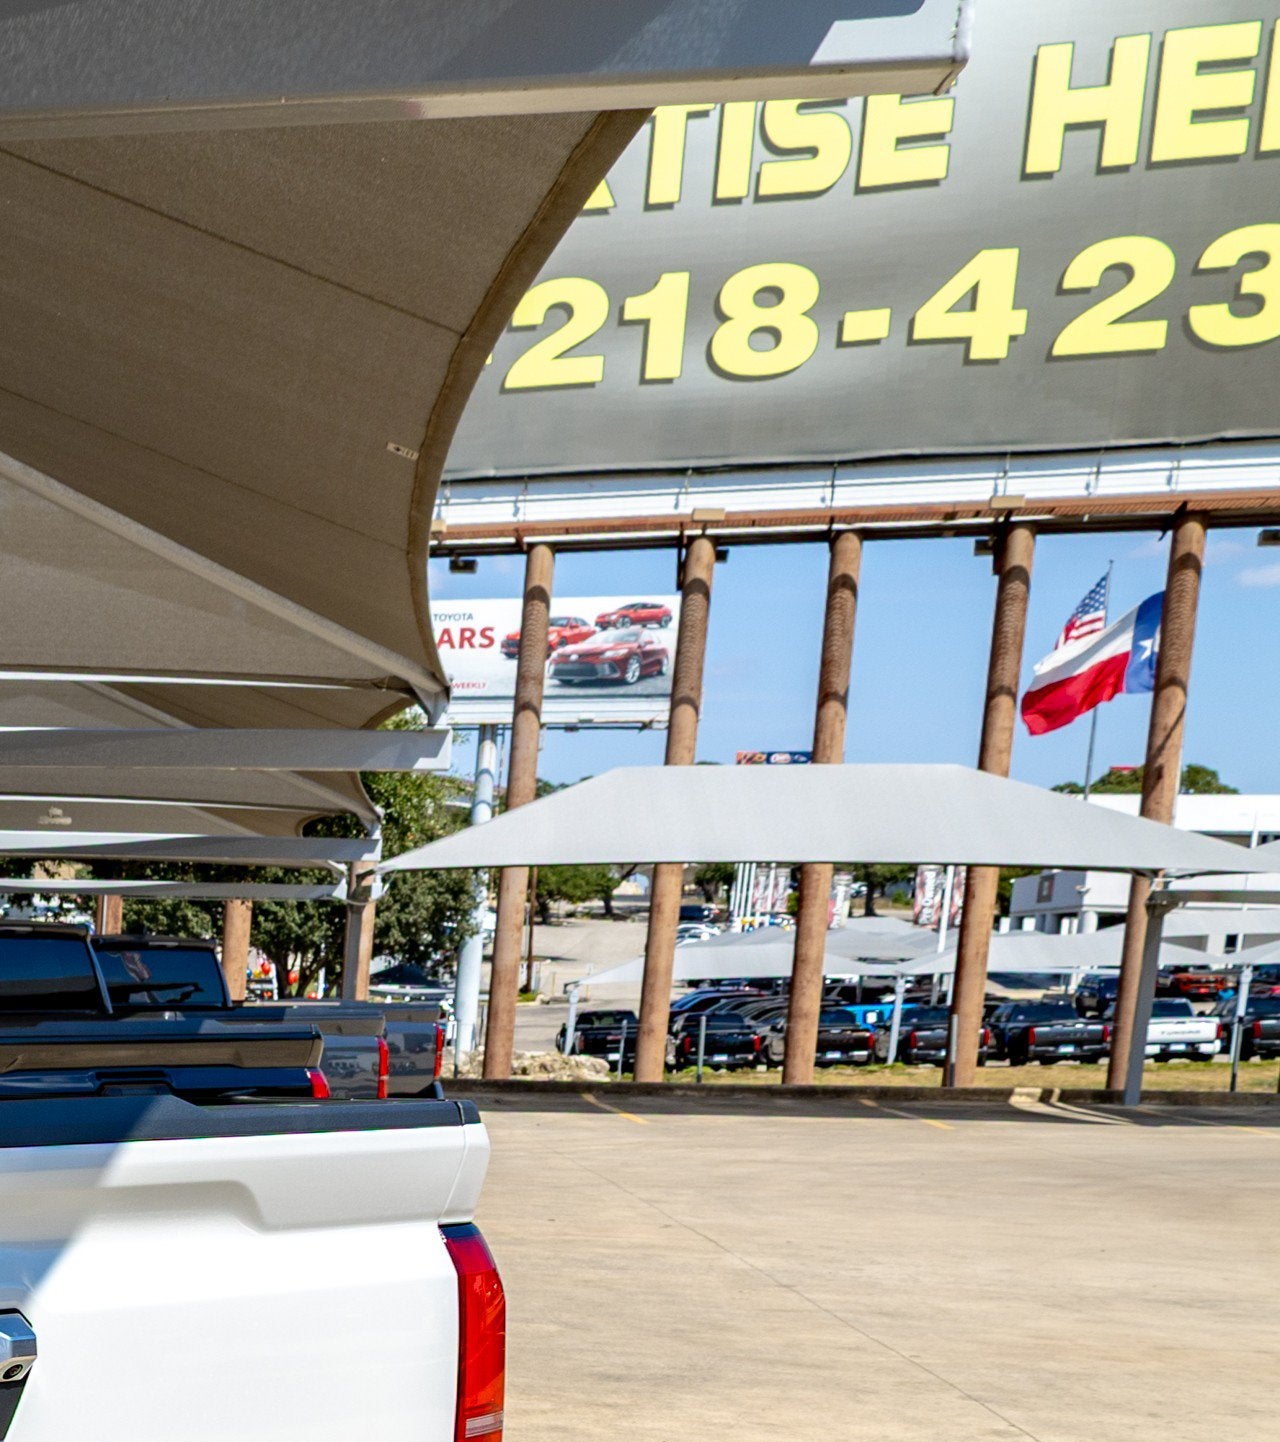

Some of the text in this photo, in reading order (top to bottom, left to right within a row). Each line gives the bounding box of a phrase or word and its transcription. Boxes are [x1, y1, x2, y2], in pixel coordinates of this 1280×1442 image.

[580, 18, 1280, 214] TISE HE
[486, 222, 1280, 393] 218-423
[433, 612, 474, 622] TOYOTA
[437, 627, 495, 649] ARS
